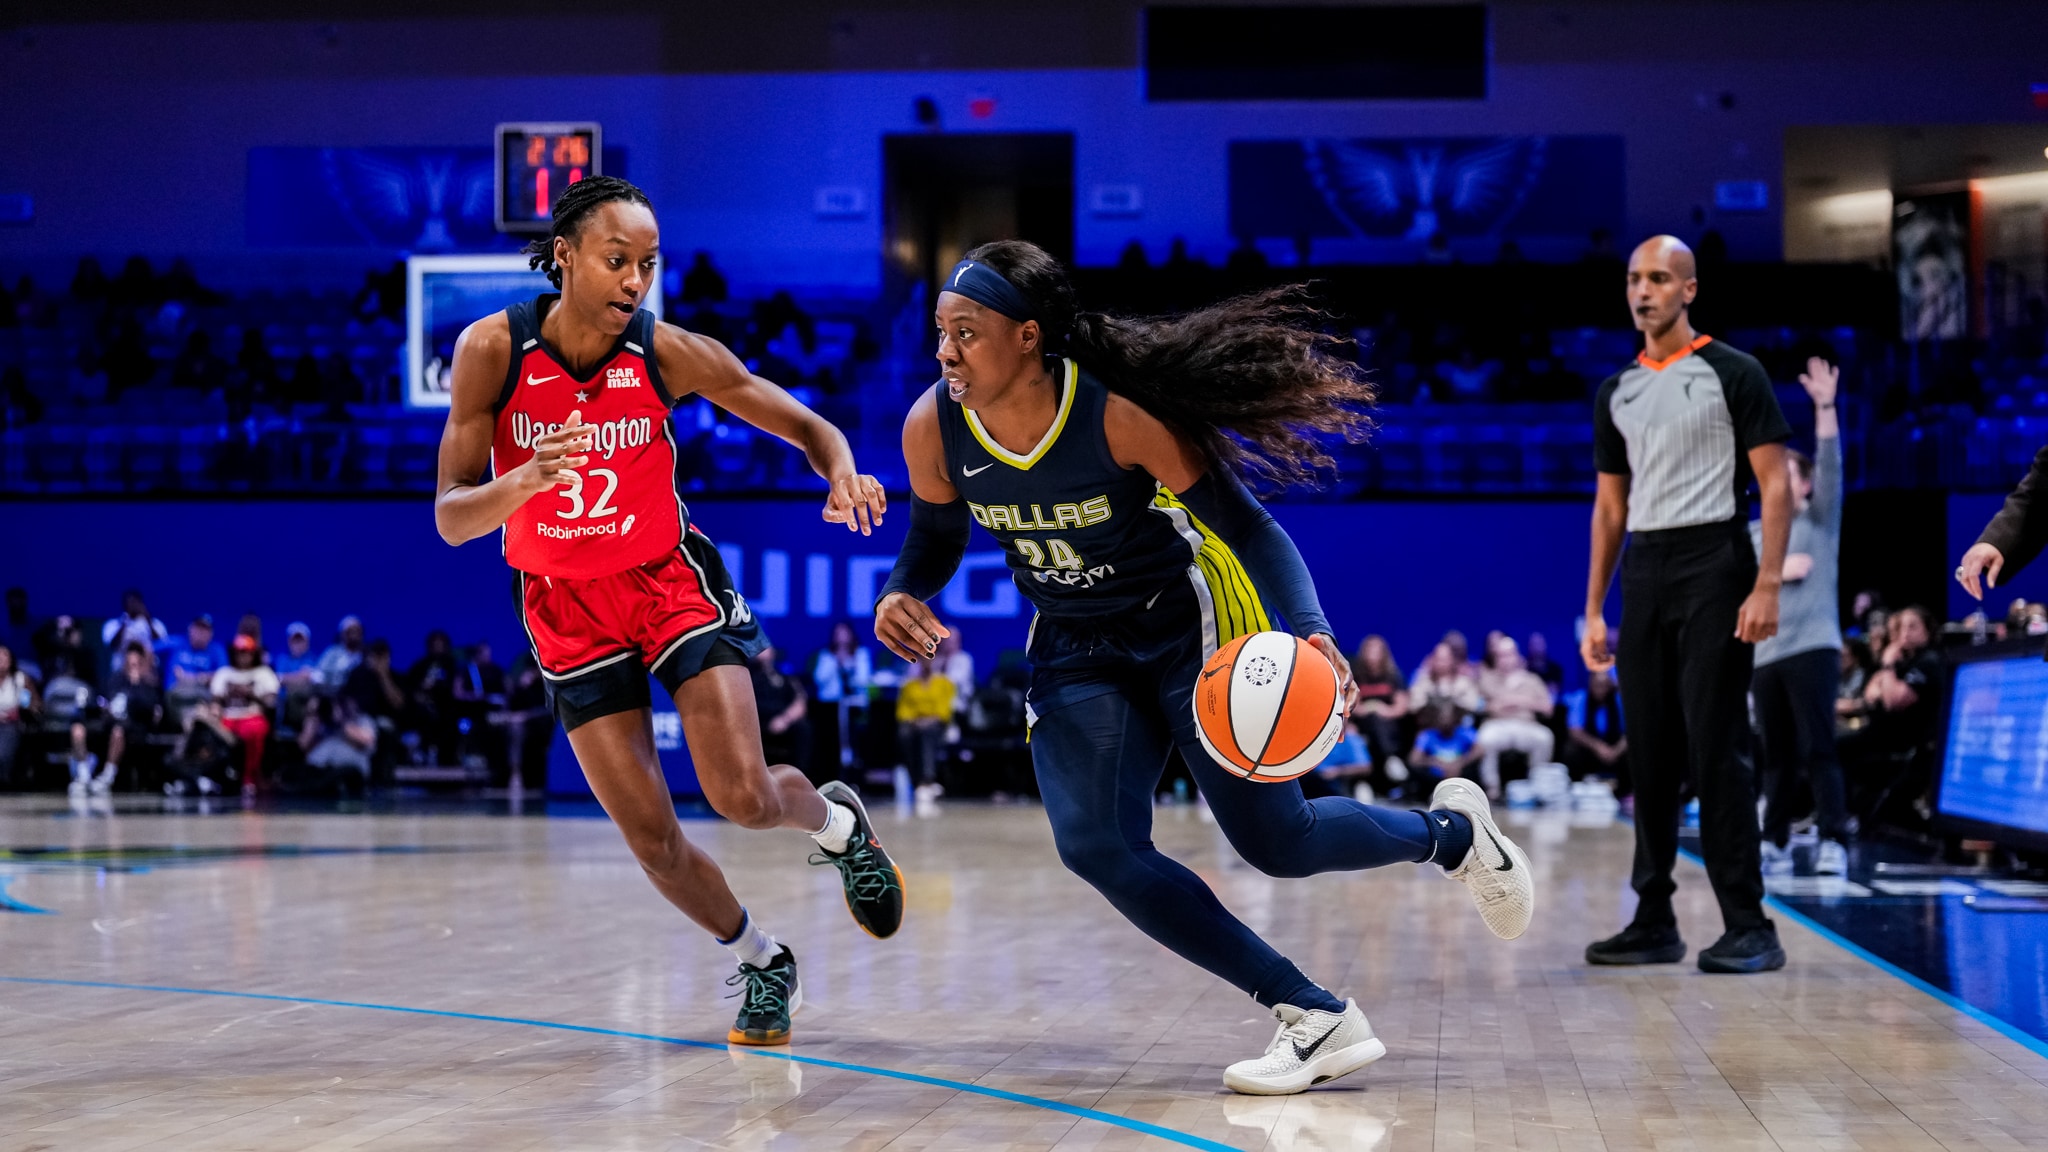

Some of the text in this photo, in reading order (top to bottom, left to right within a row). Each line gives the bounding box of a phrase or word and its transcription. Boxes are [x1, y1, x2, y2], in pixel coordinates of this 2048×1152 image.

[606, 367, 634, 379] CAR
[607, 377, 642, 389] max
[511, 411, 652, 461] Wangton
[556, 467, 619, 520] 32
[967, 494, 1112, 531] DALLAS
[537, 520, 616, 540] Robinhood
[1014, 538, 1085, 570] 24
